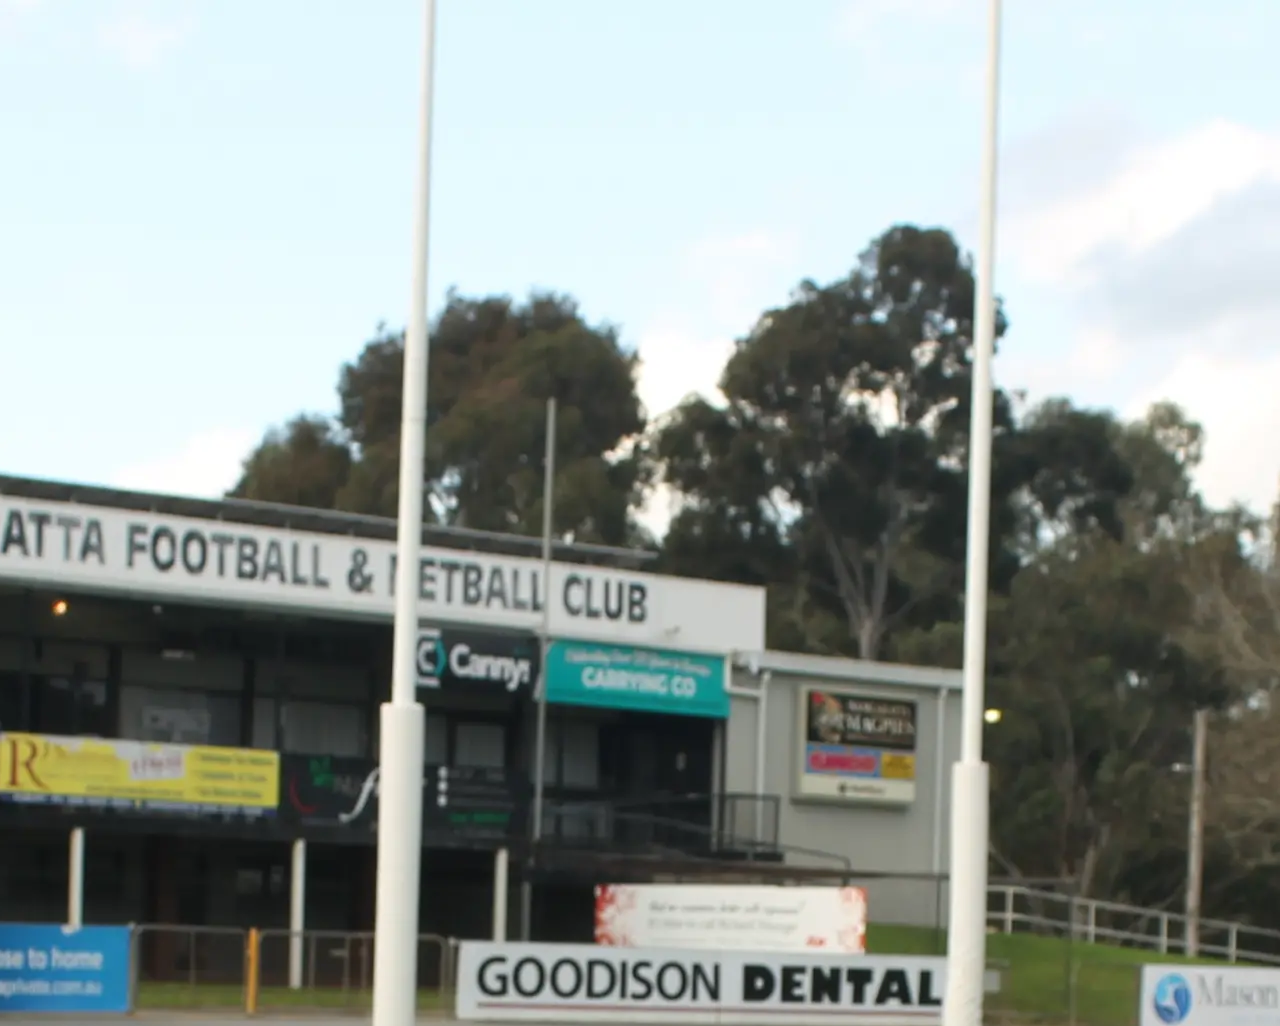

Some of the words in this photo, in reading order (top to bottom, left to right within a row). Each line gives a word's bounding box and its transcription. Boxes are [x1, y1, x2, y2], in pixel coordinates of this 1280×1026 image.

[125, 522, 330, 589] FOOTBALL
[347, 547, 375, 594] &
[562, 573, 648, 623] CLUB
[28, 948, 48, 970] to
[51, 947, 104, 971] home
[477, 955, 721, 1002] GOODISON
[743, 964, 942, 1006] DENTAL
[1197, 972, 1279, 1010] Mason
